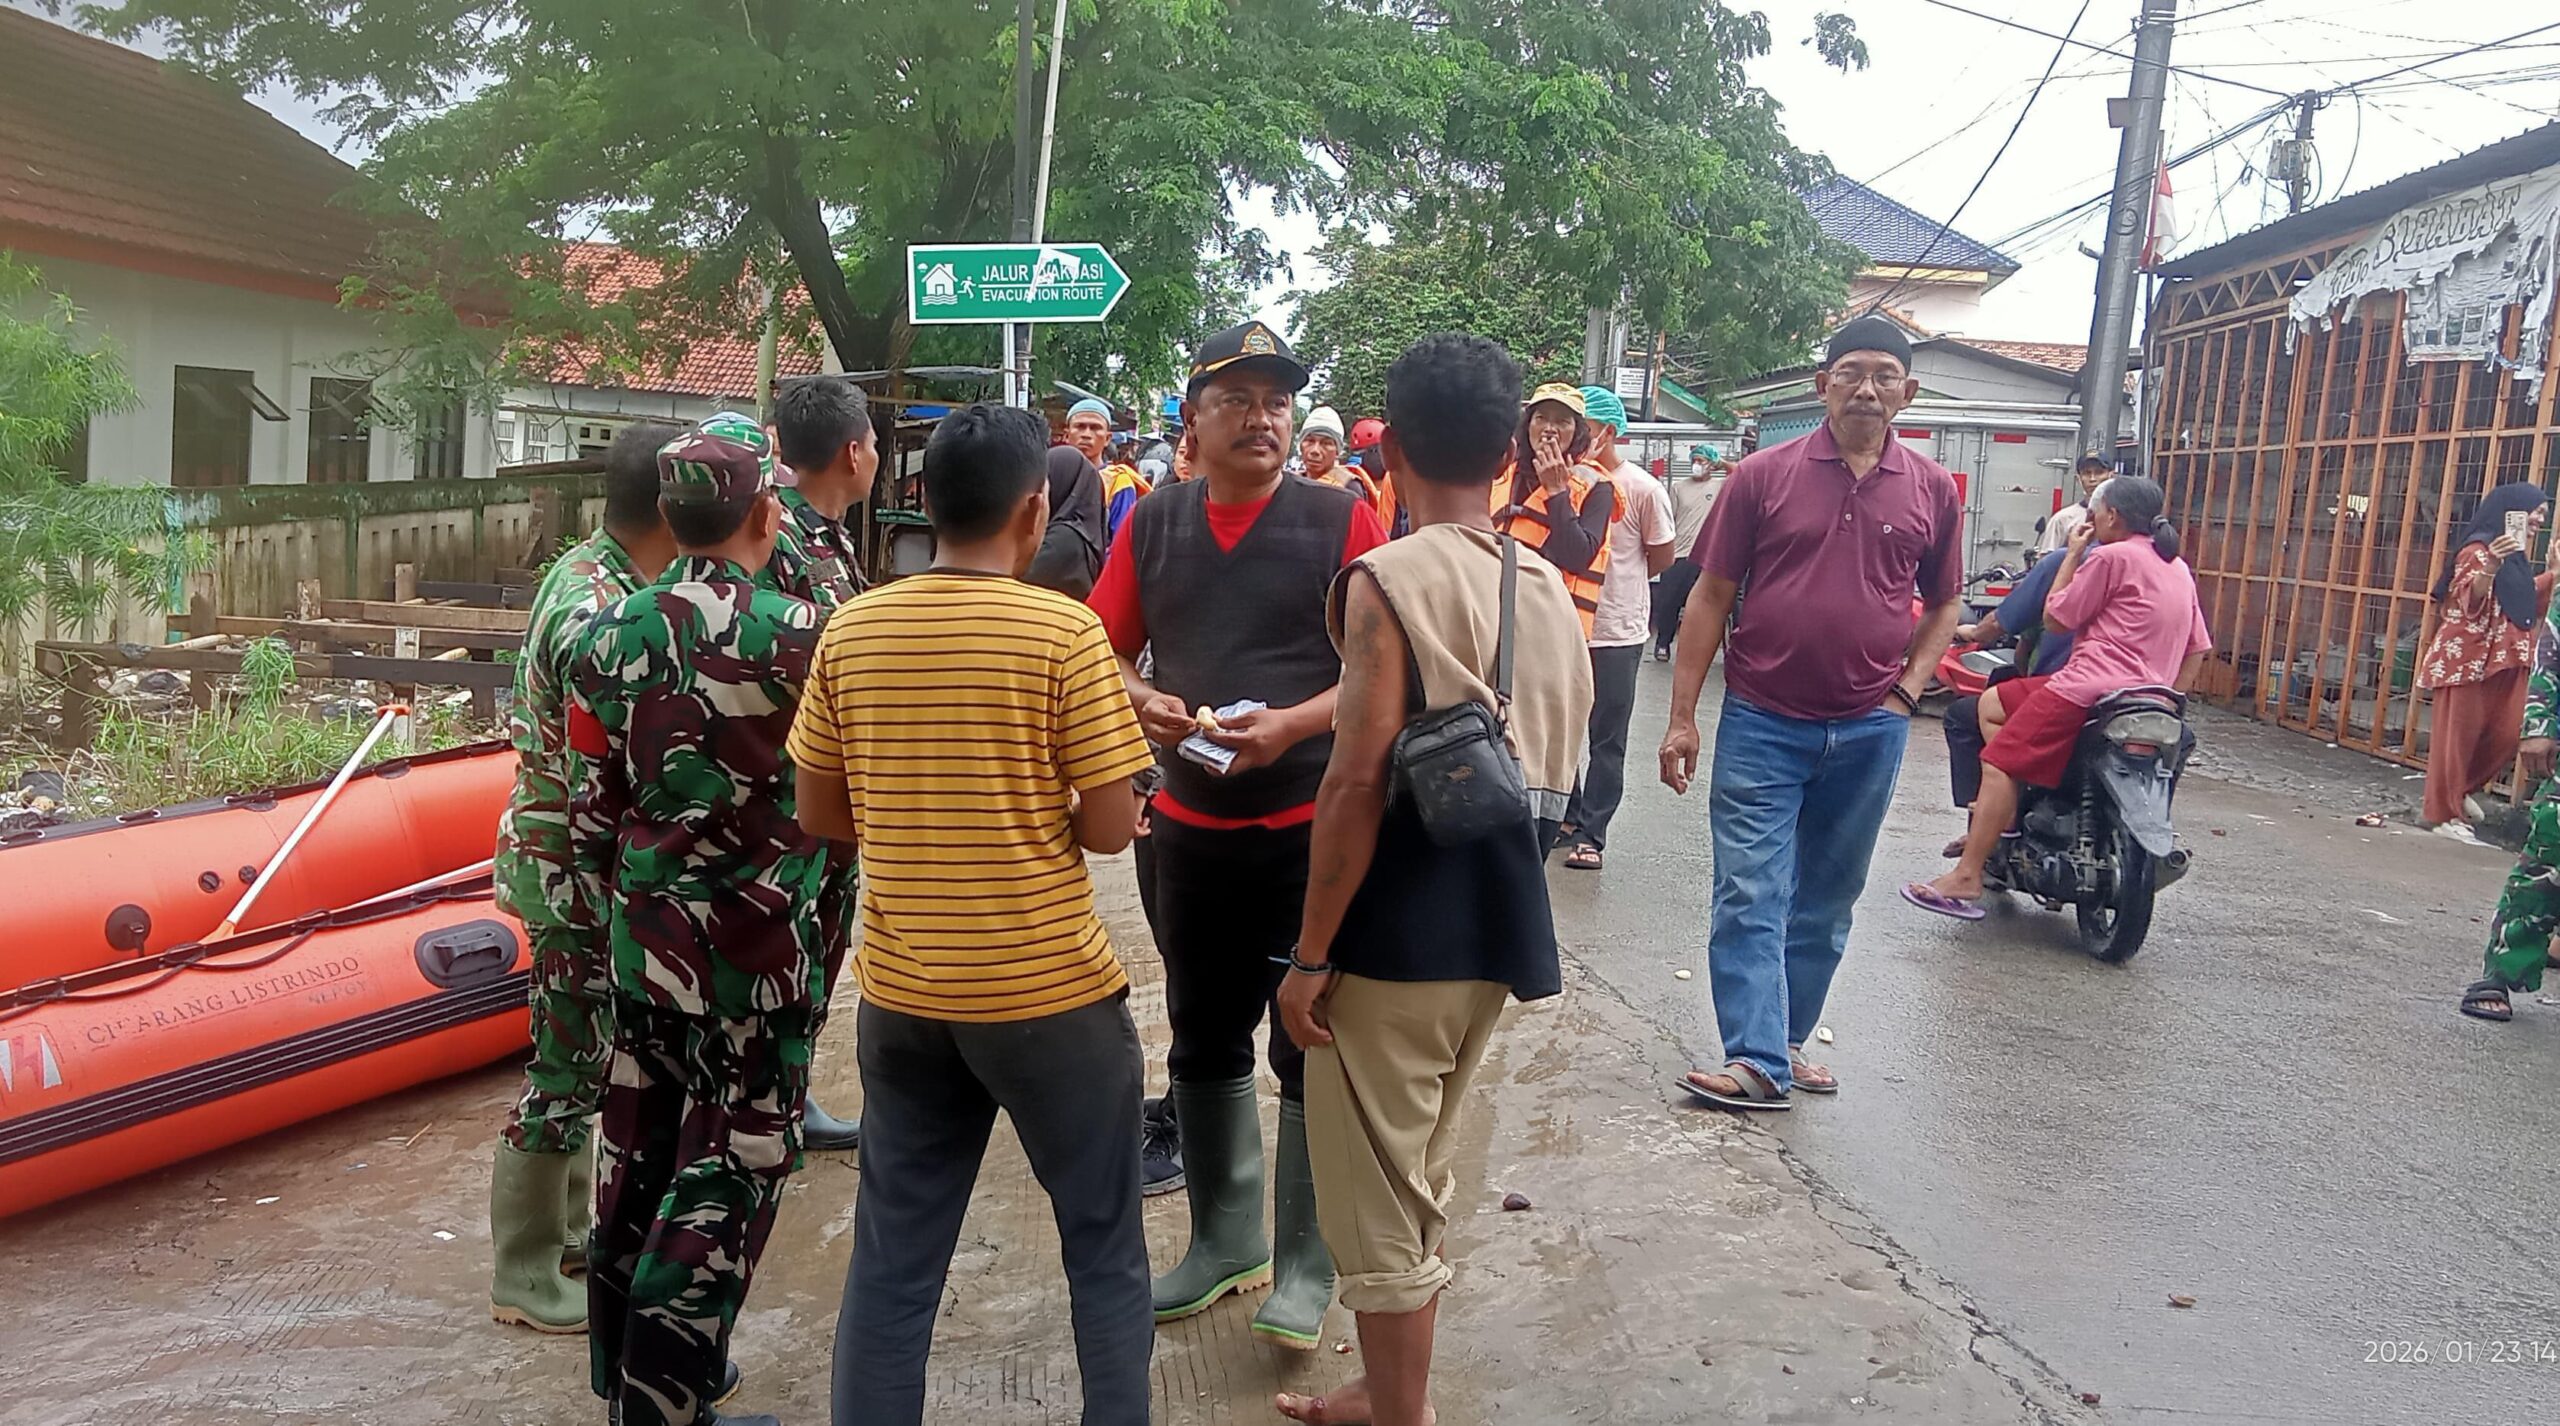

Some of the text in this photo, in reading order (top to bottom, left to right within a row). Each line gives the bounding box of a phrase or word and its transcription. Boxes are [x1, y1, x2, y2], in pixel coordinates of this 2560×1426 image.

[982, 264, 1029, 282] JALUR
[1062, 287, 1105, 301] ROUTE
[231, 956, 360, 1007] LISTRINDO
